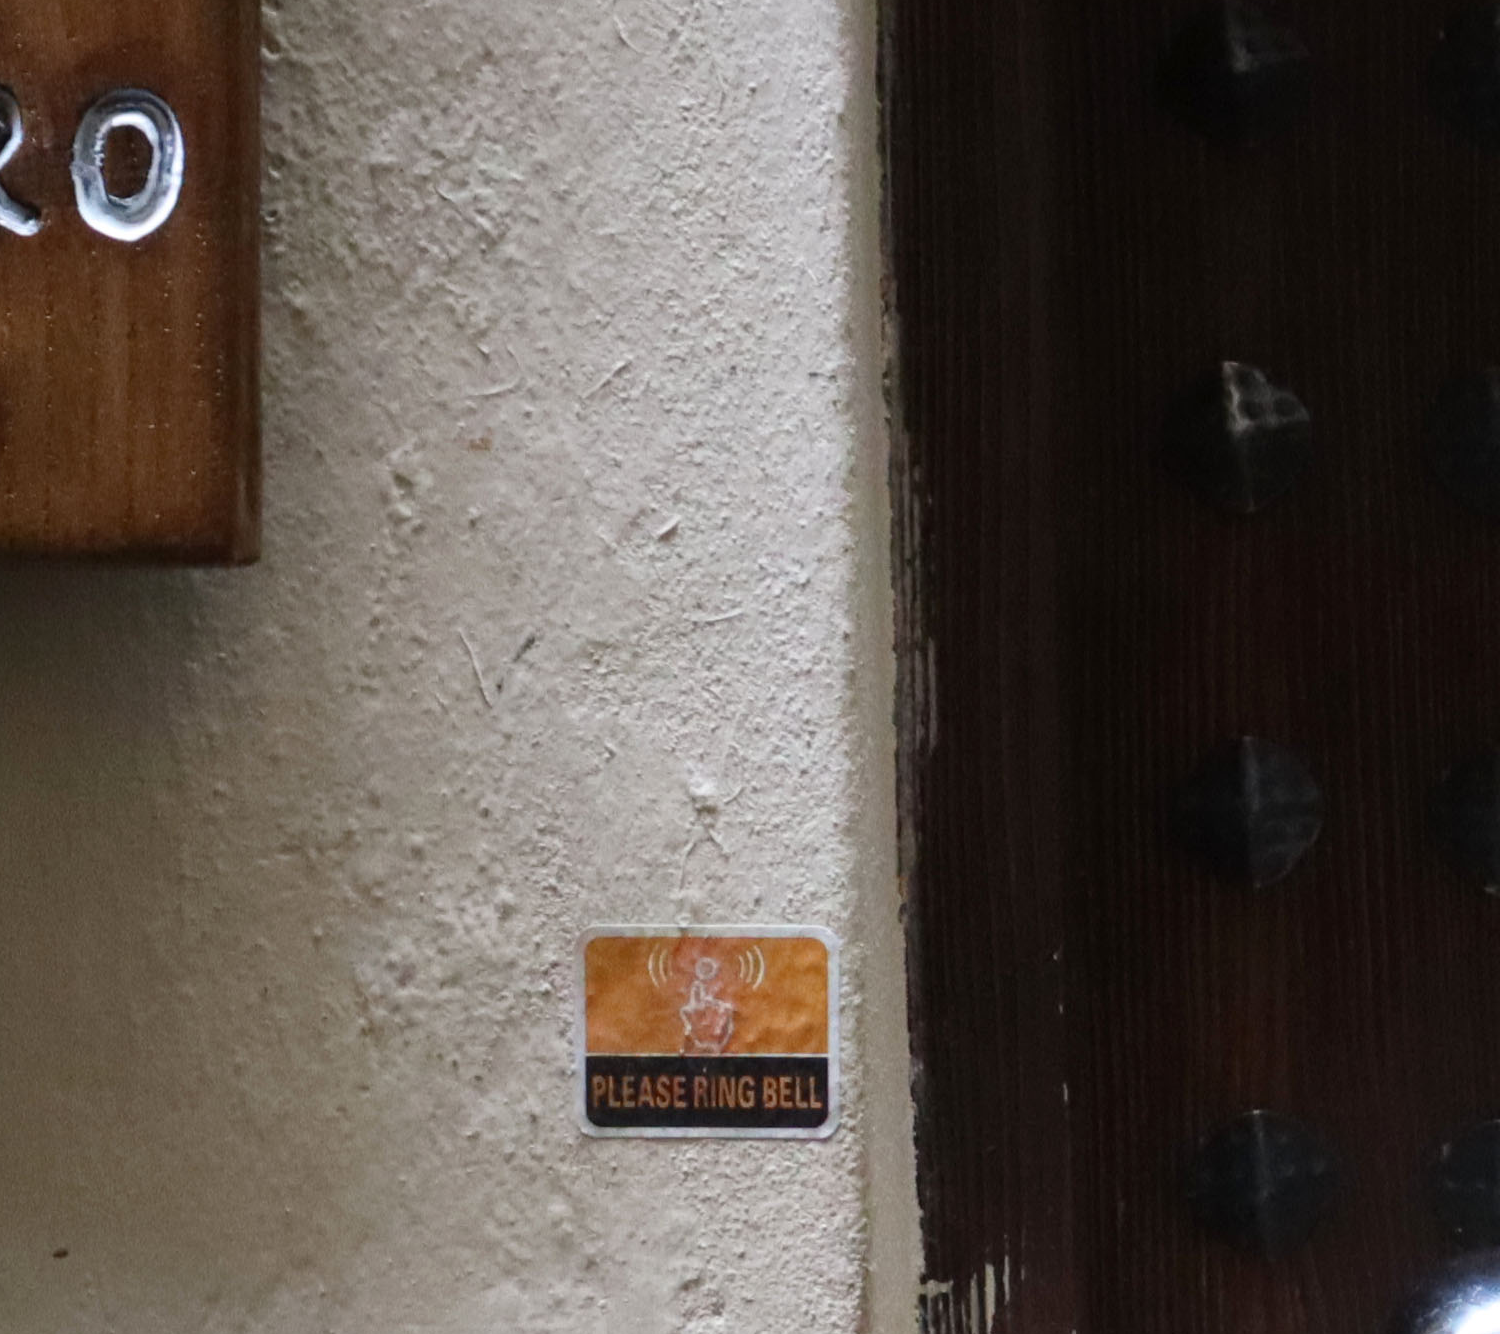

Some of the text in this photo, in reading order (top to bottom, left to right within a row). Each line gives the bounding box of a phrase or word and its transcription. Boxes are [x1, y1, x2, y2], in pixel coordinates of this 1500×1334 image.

[591, 1075, 823, 1109] PLEASE RING BELL
